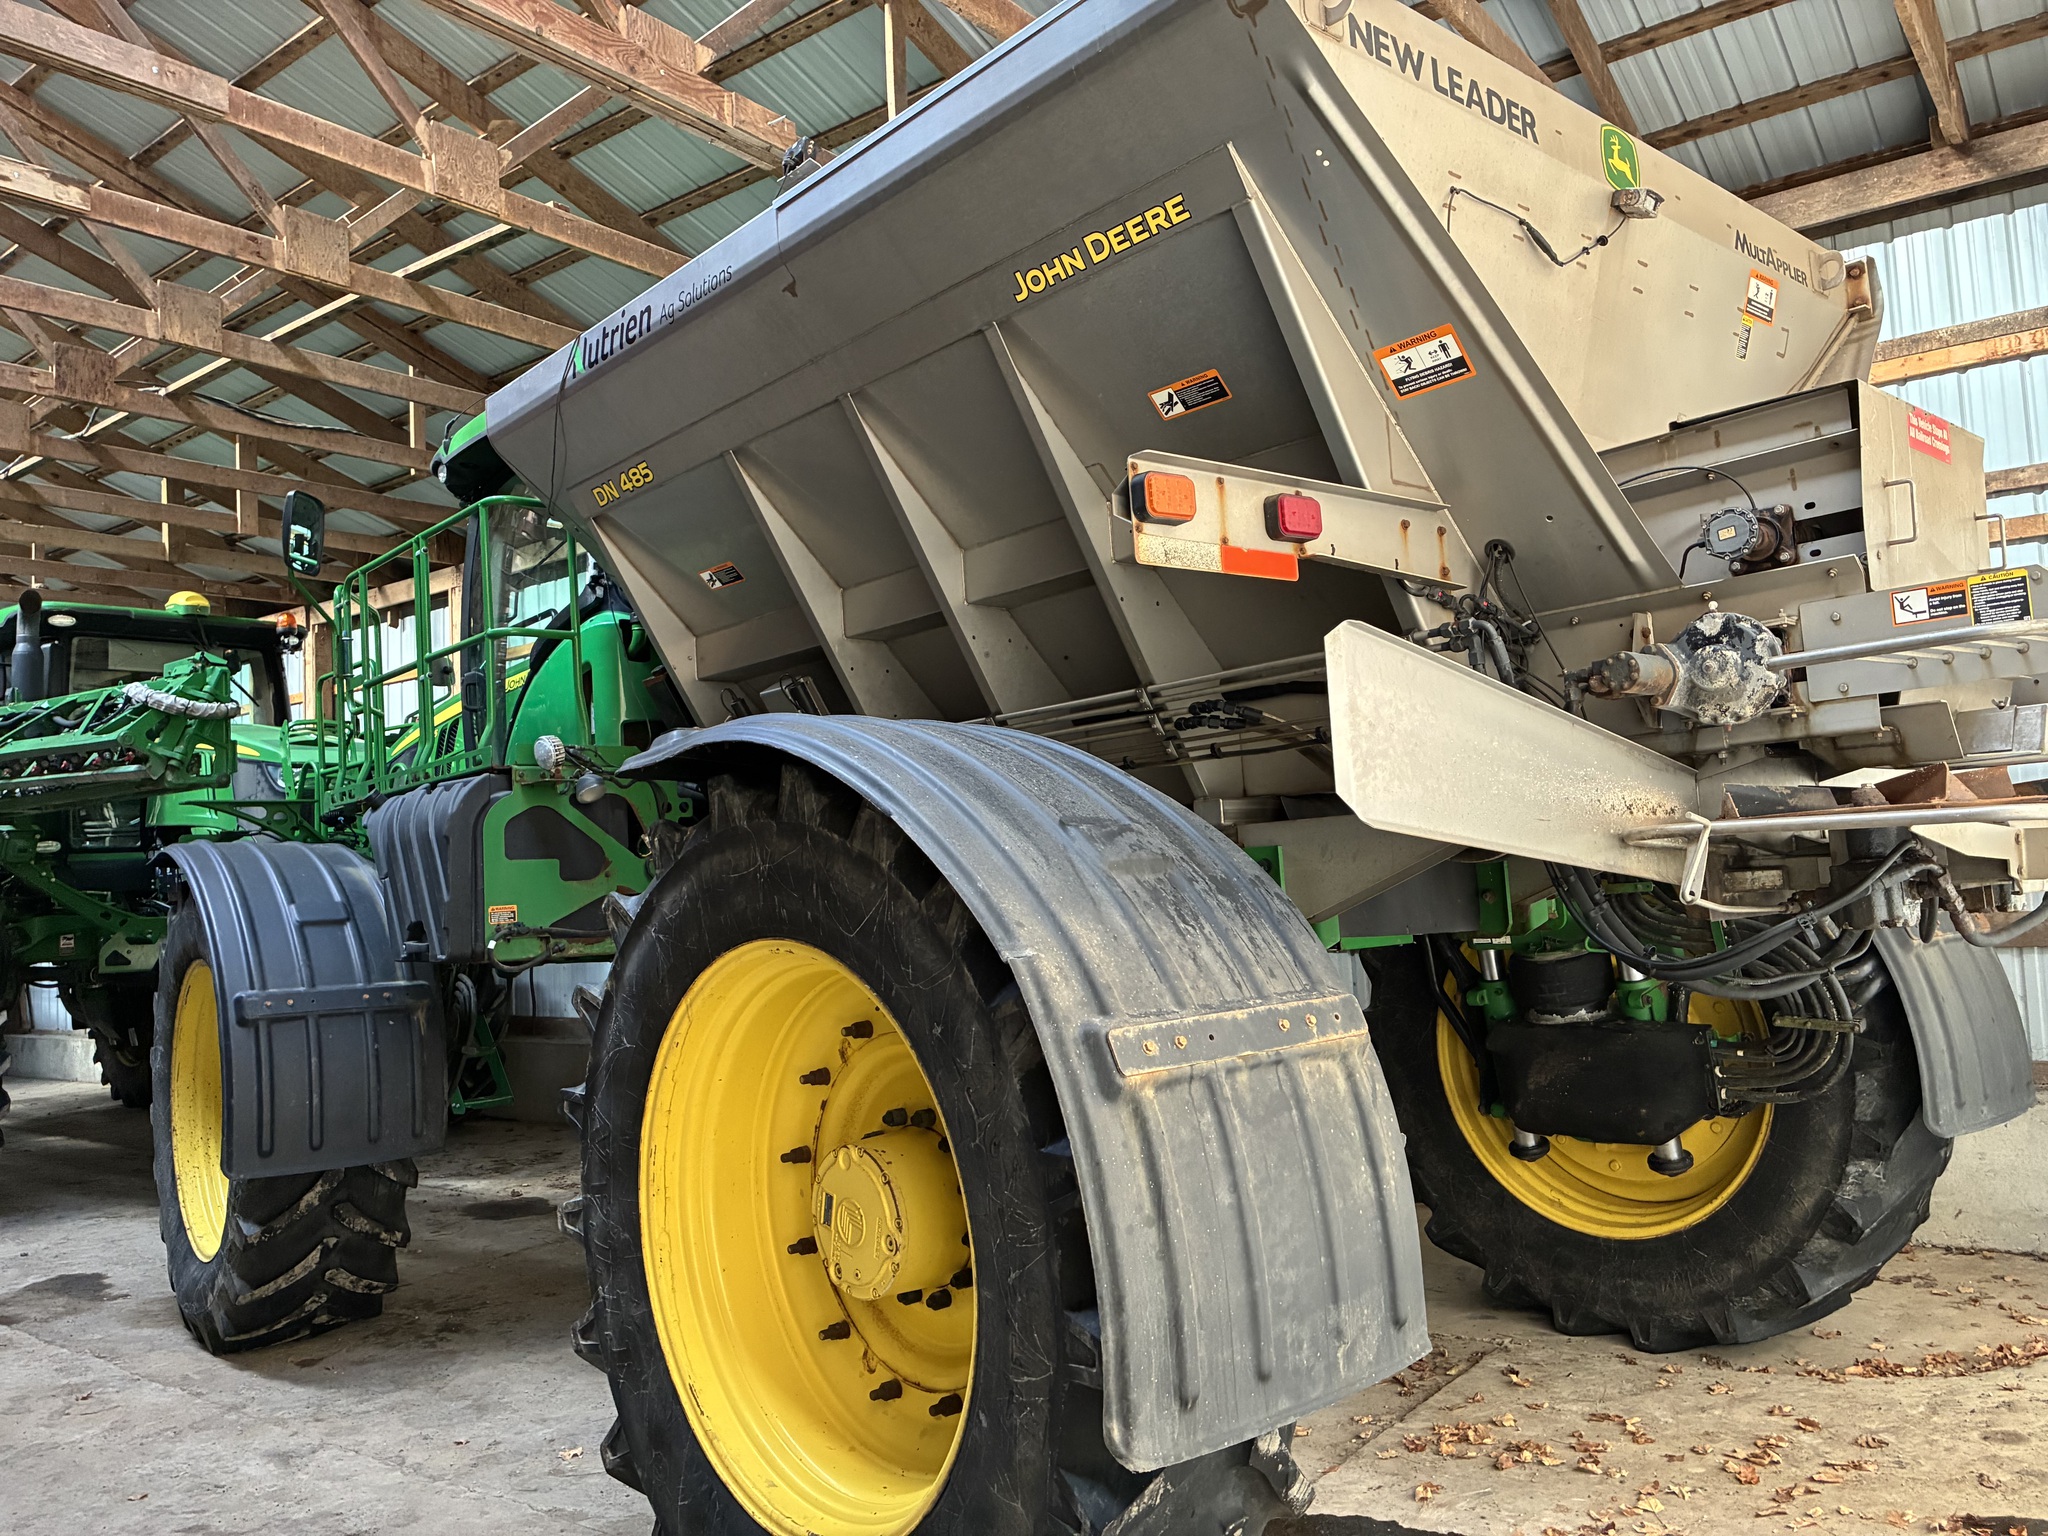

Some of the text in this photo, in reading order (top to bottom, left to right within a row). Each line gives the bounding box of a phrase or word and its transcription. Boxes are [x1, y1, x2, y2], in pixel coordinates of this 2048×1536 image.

[1348, 12, 1539, 145] NEW LEADER
[1014, 192, 1192, 303] JOHN DEERE
[572, 266, 732, 379] Nutrien Ag Solutions
[1397, 330, 1437, 350] WARNING
[1186, 373, 1208, 384] WARNING
[592, 460, 654, 507] DN 485
[1936, 582, 1964, 591] WARNING
[1988, 572, 2014, 580] CAUTION
